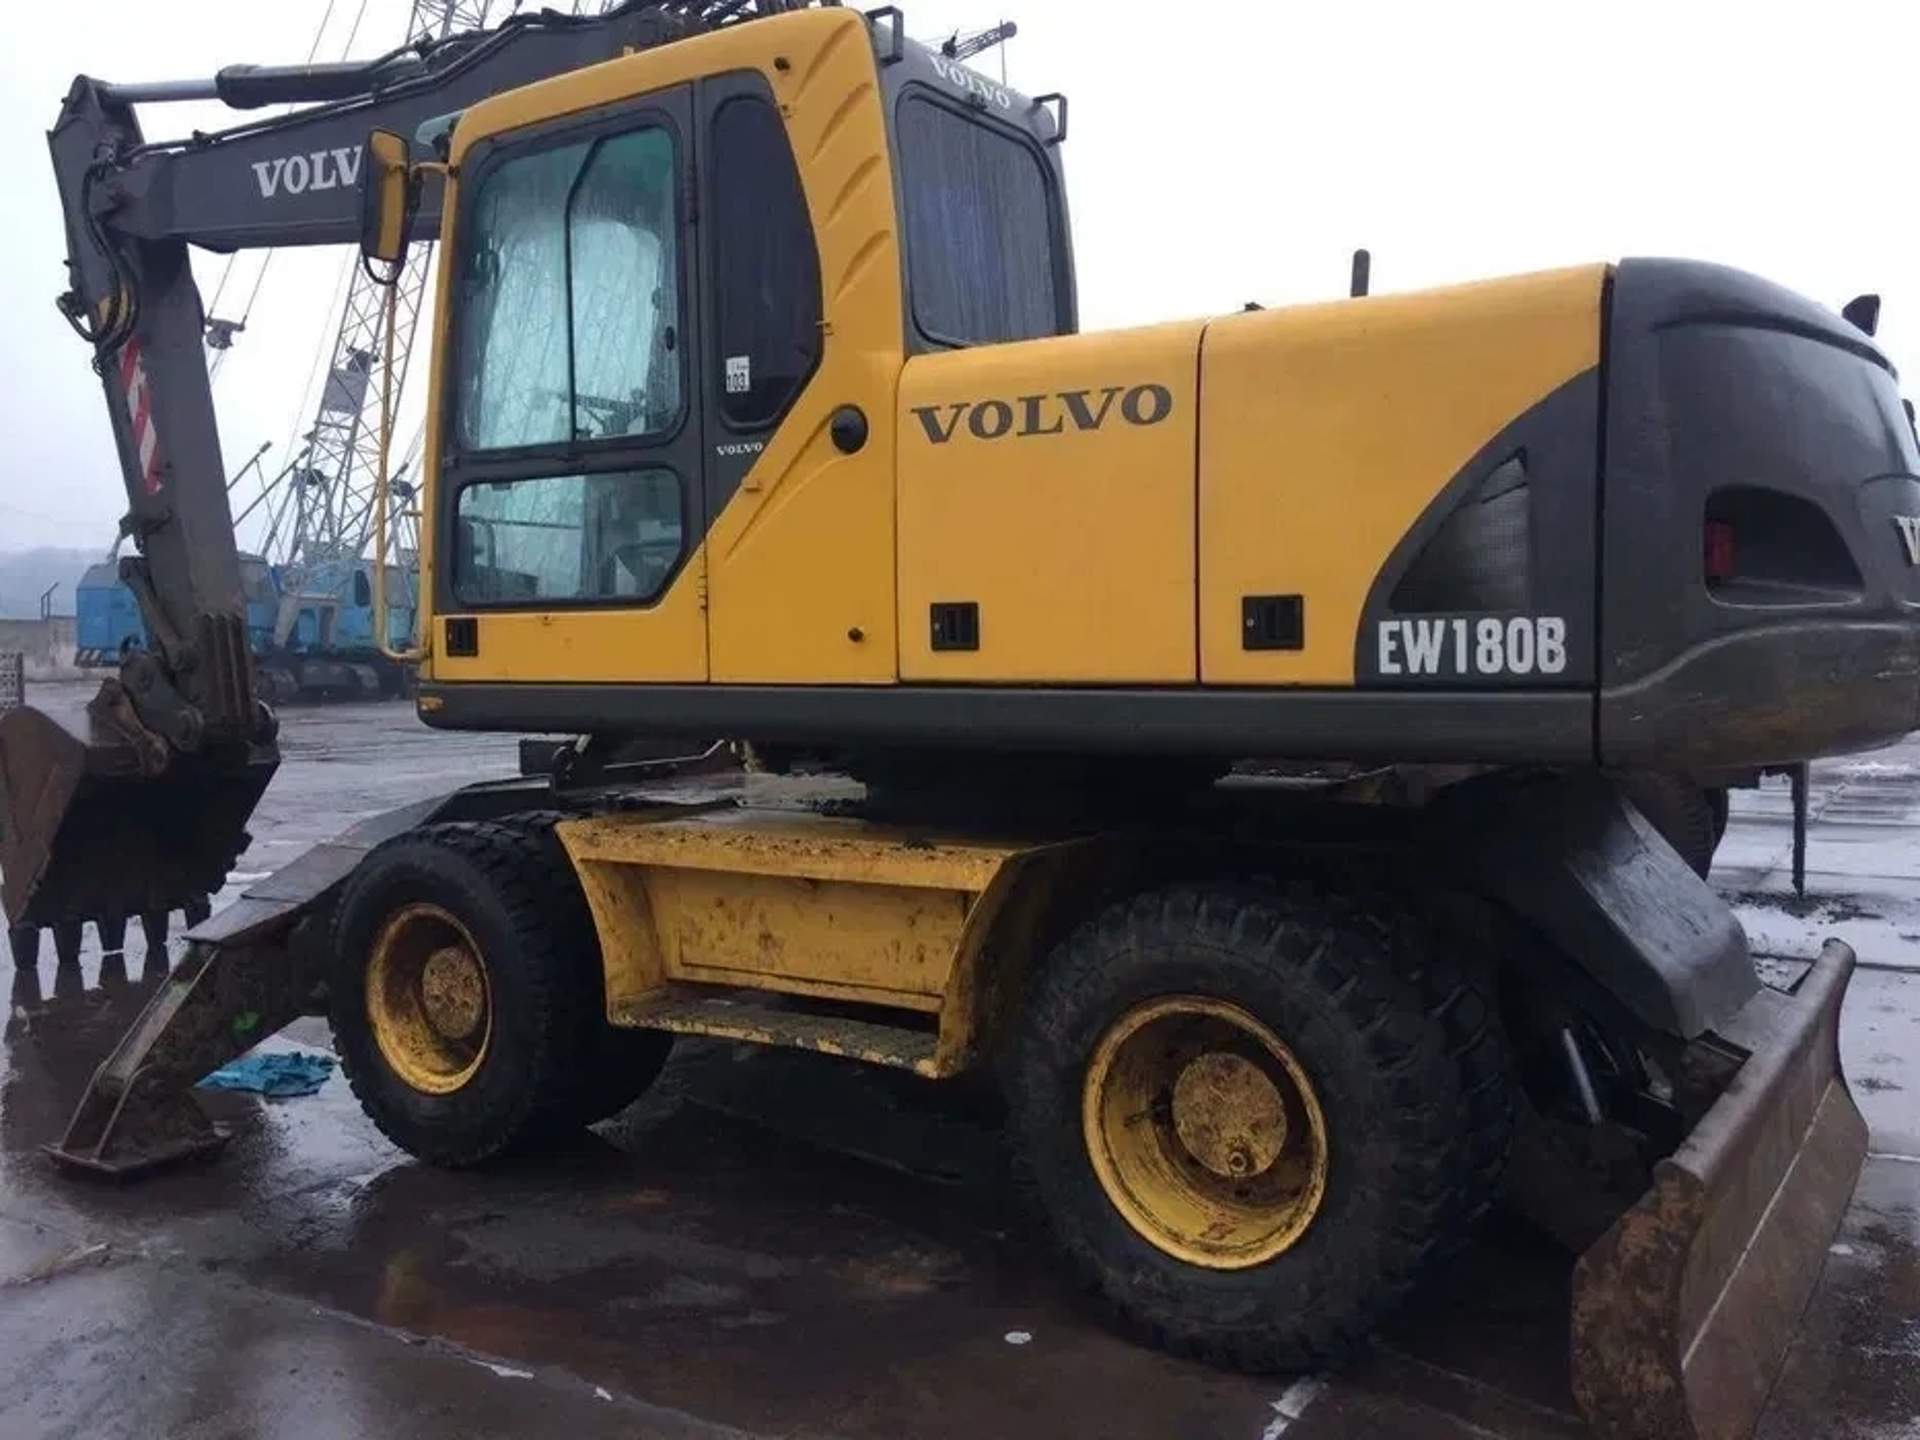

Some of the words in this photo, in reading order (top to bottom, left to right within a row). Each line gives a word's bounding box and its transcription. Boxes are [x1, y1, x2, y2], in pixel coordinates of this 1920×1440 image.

[927, 54, 1011, 110] VOLVO
[252, 145, 364, 198] VOLV
[910, 383, 1173, 444] VOLVO
[716, 442, 763, 456] VOLVO
[1378, 616, 1566, 674] EW180B
